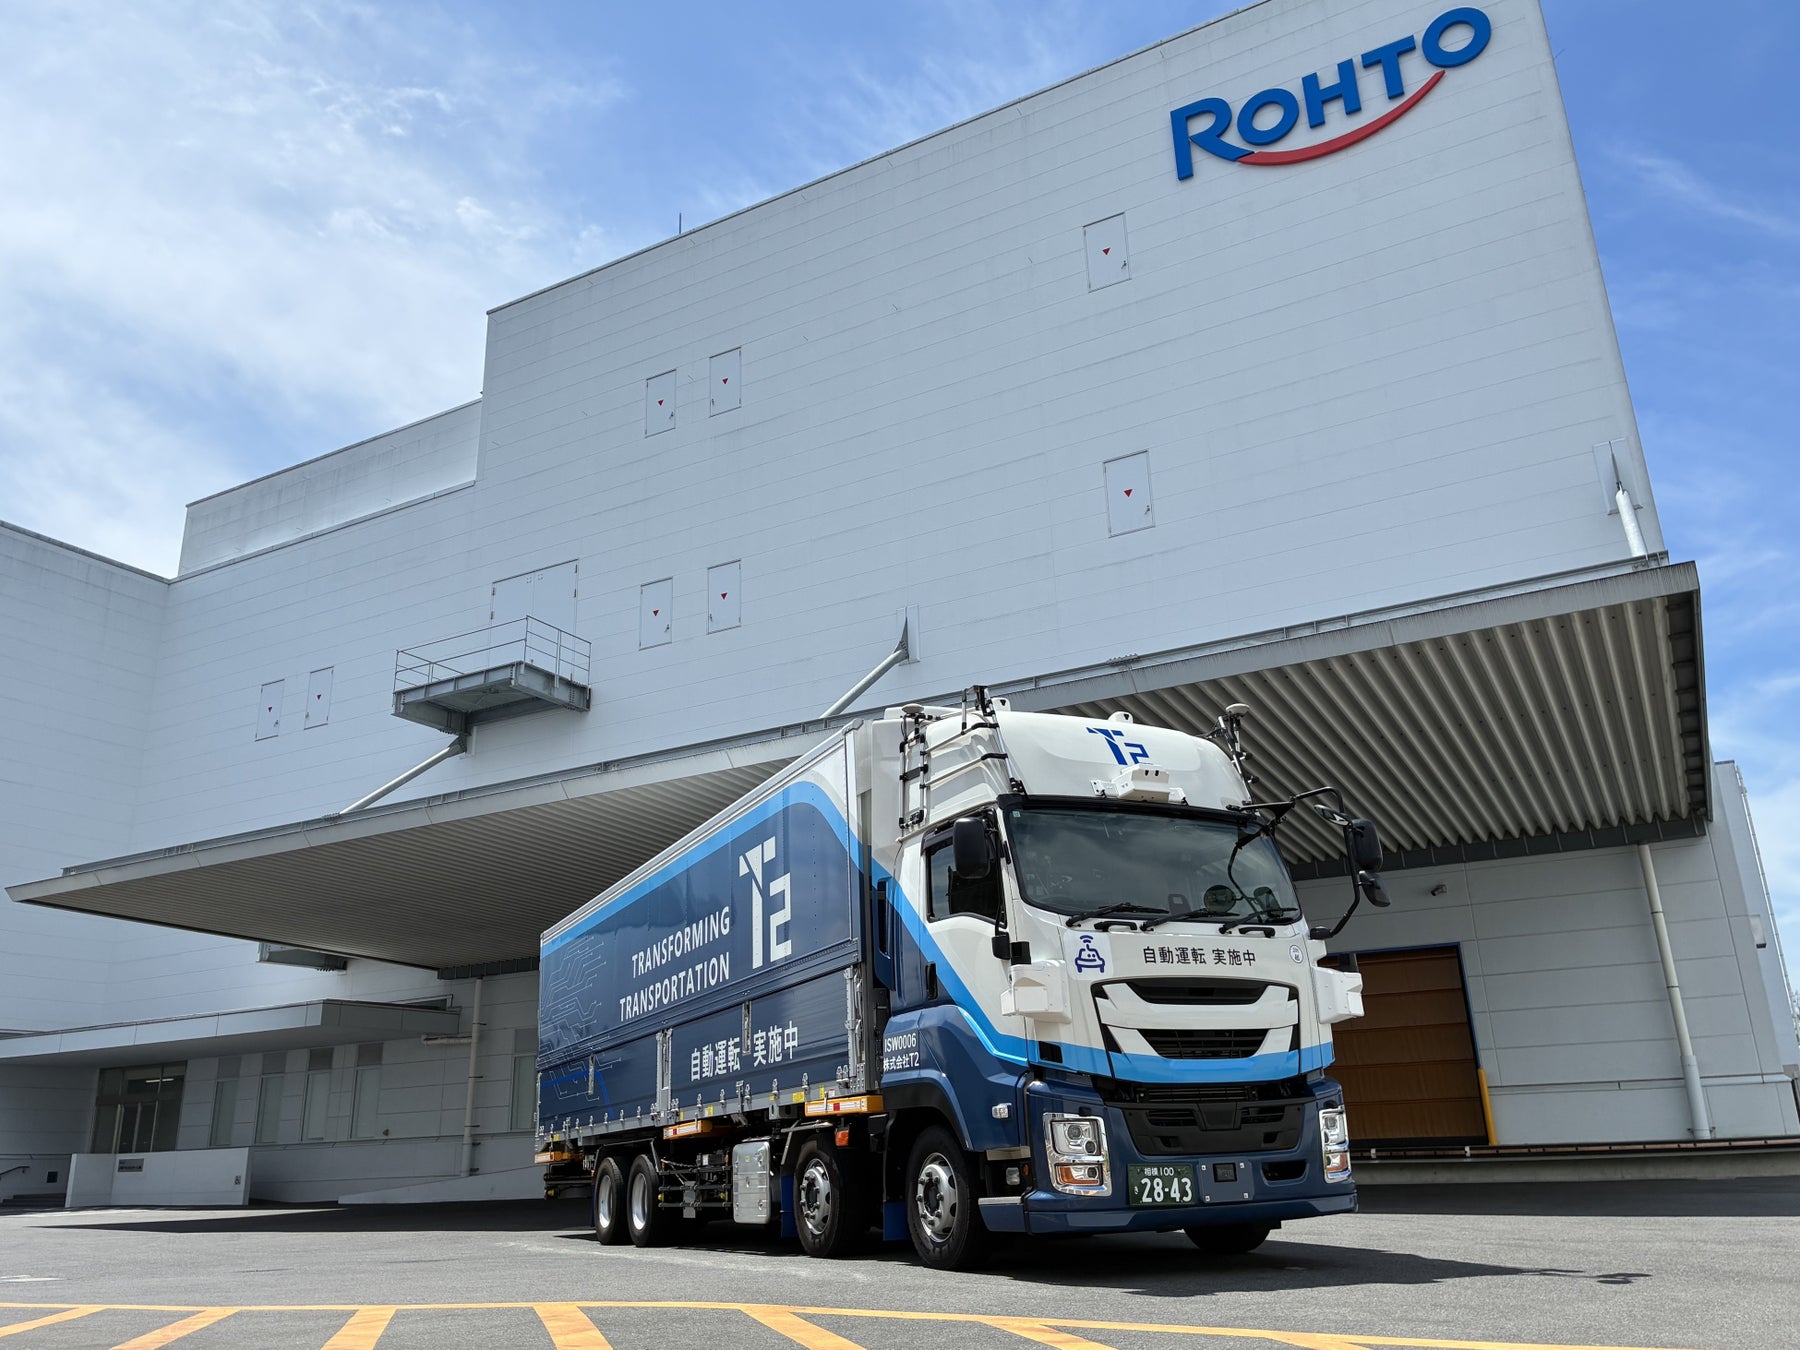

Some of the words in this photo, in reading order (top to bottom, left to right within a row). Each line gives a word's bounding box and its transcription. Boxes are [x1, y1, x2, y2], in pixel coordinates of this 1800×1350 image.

[1170, 7, 1491, 180] ROHTO
[1086, 727, 1149, 765] T2
[739, 836, 791, 969] T2
[632, 906, 730, 978] TRANSFORMING
[1143, 946, 1207, 965] 自動運転
[1212, 948, 1256, 966] 実施中
[619, 952, 730, 1021] TRANSPORTATION
[691, 1037, 741, 1081] 自動運転
[753, 1020, 799, 1067] 実施中
[883, 1052, 920, 1072] 株式会社T2
[884, 1033, 917, 1052] ISW0006
[1141, 1178, 1192, 1202] 28-43
